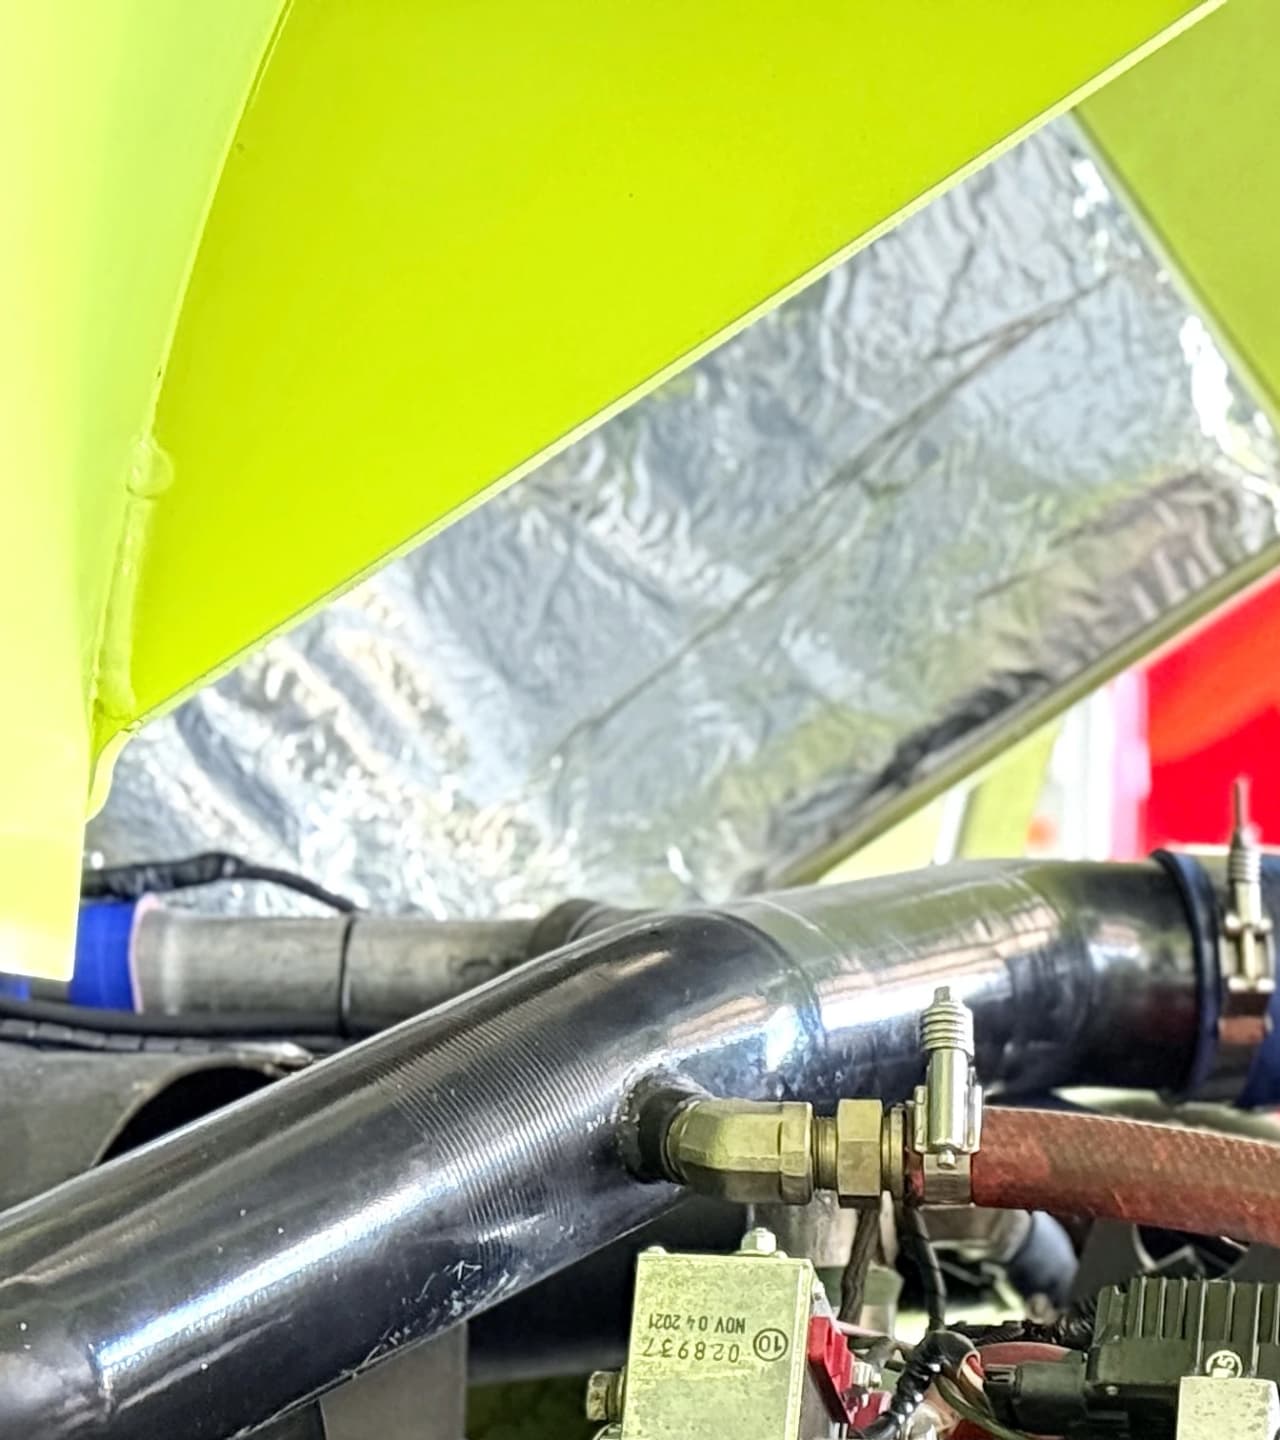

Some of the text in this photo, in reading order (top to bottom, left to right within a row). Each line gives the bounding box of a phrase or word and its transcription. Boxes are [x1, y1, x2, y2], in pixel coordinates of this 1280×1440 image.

[648, 1313, 681, 1330] 2021
[642, 1337, 740, 1363] 028937
[758, 1335, 782, 1353] 10
